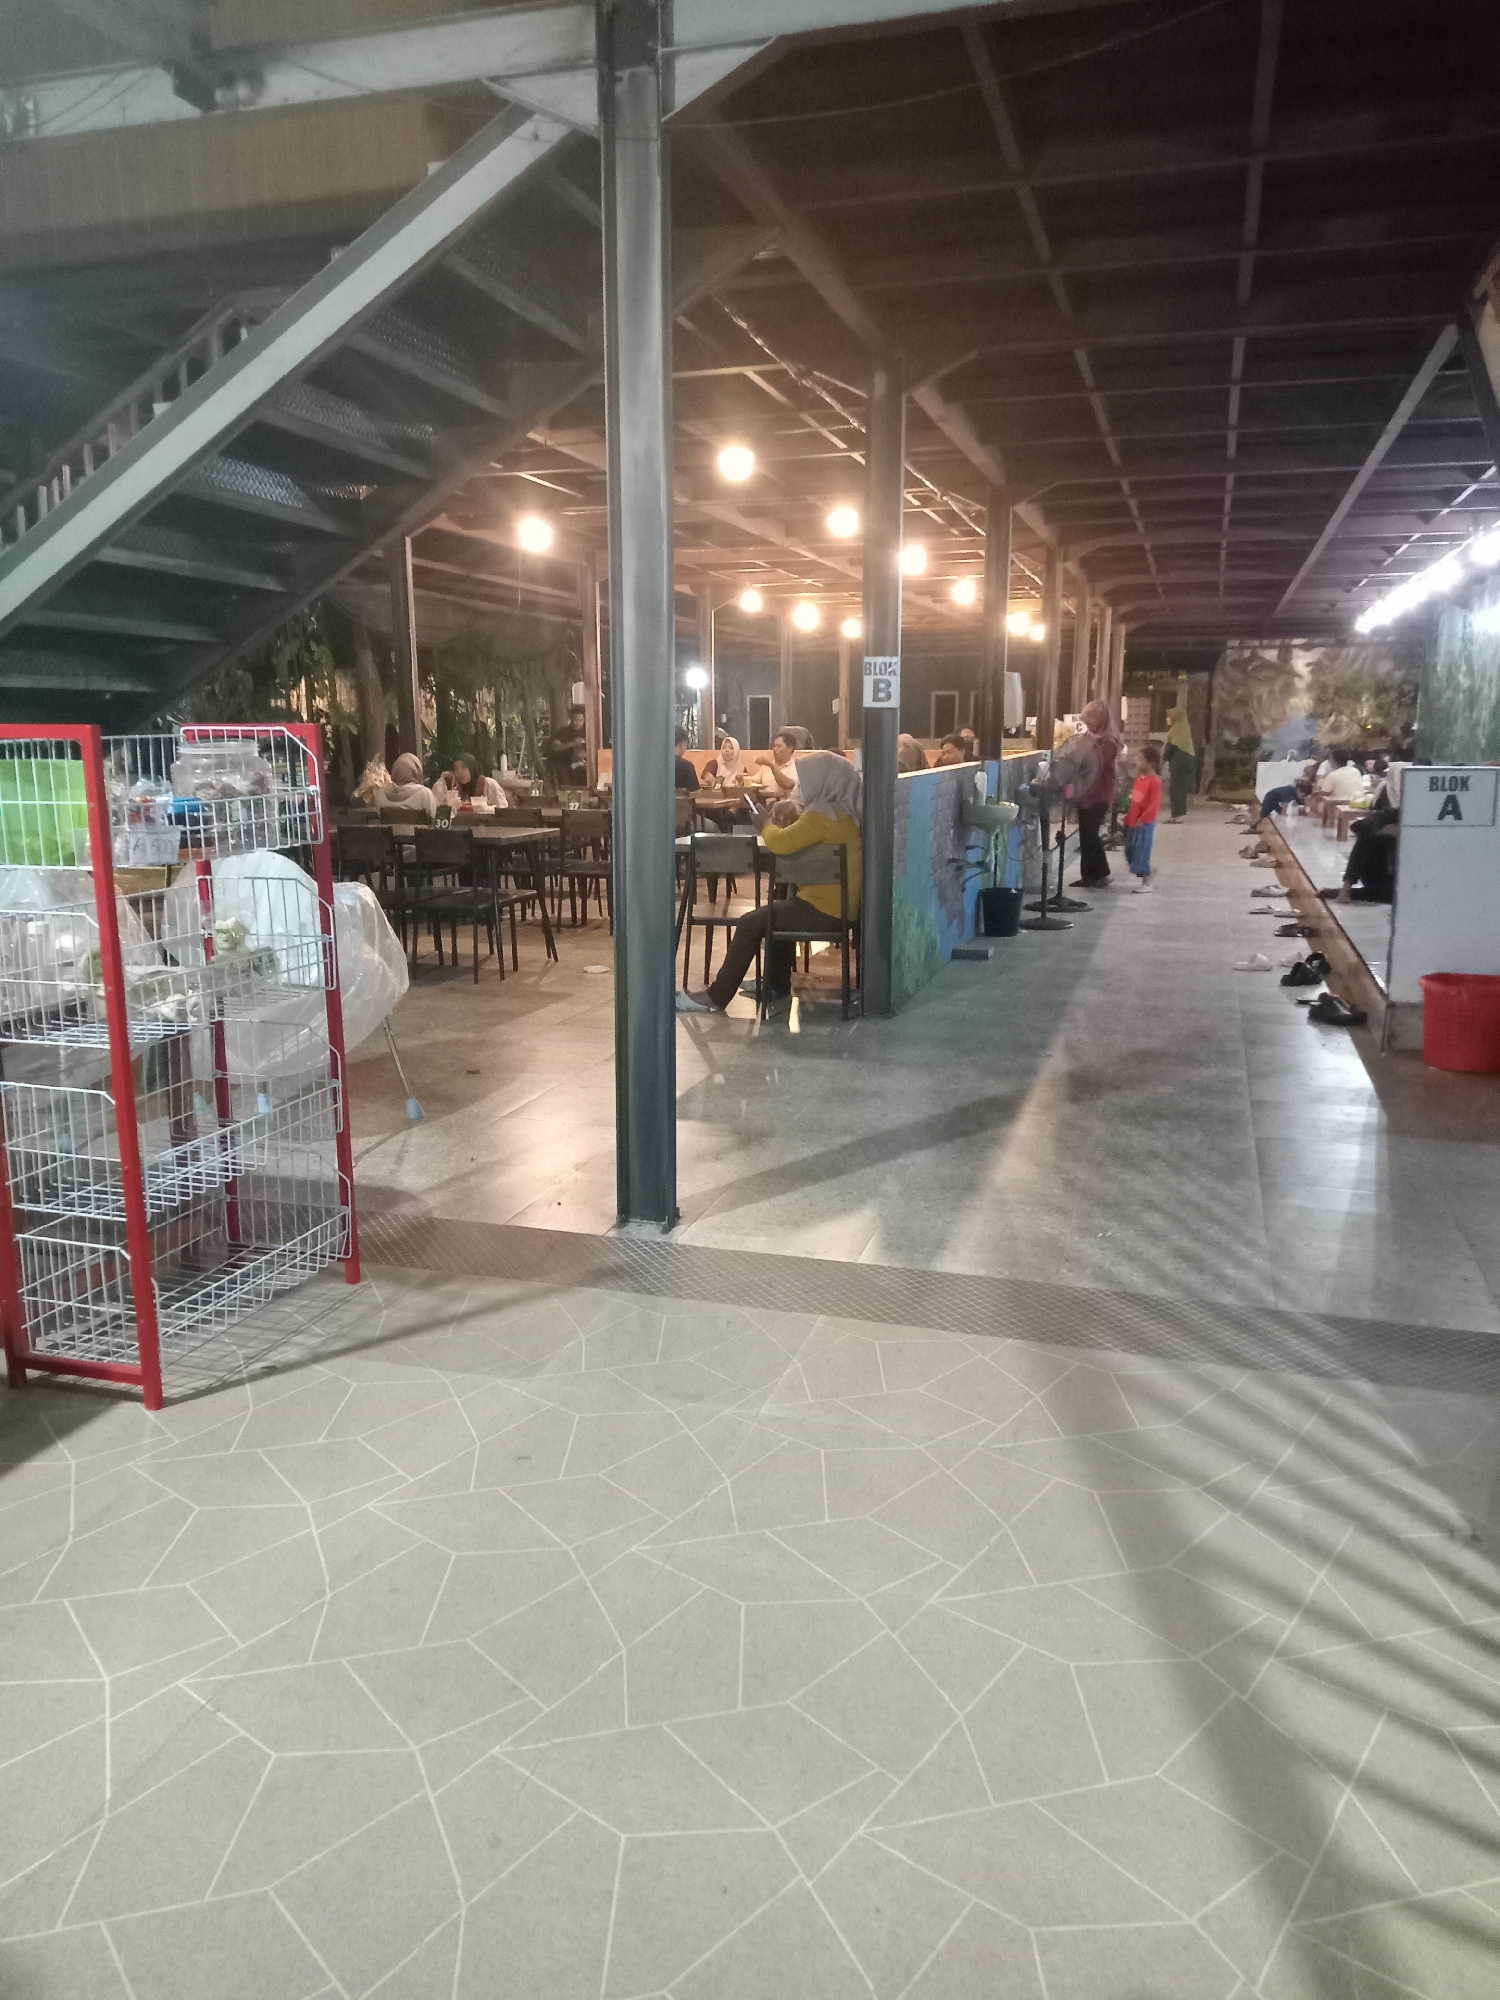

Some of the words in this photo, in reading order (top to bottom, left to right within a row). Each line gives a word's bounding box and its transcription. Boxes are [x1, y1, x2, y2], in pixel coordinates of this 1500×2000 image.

[864, 661, 898, 676] BLOK
[872, 678, 892, 703] B
[1076, 722, 1083, 732] C
[1429, 775, 1471, 792] BLOK
[568, 802, 580, 811] 27
[1437, 793, 1463, 821] A
[434, 818, 449, 829] 30
